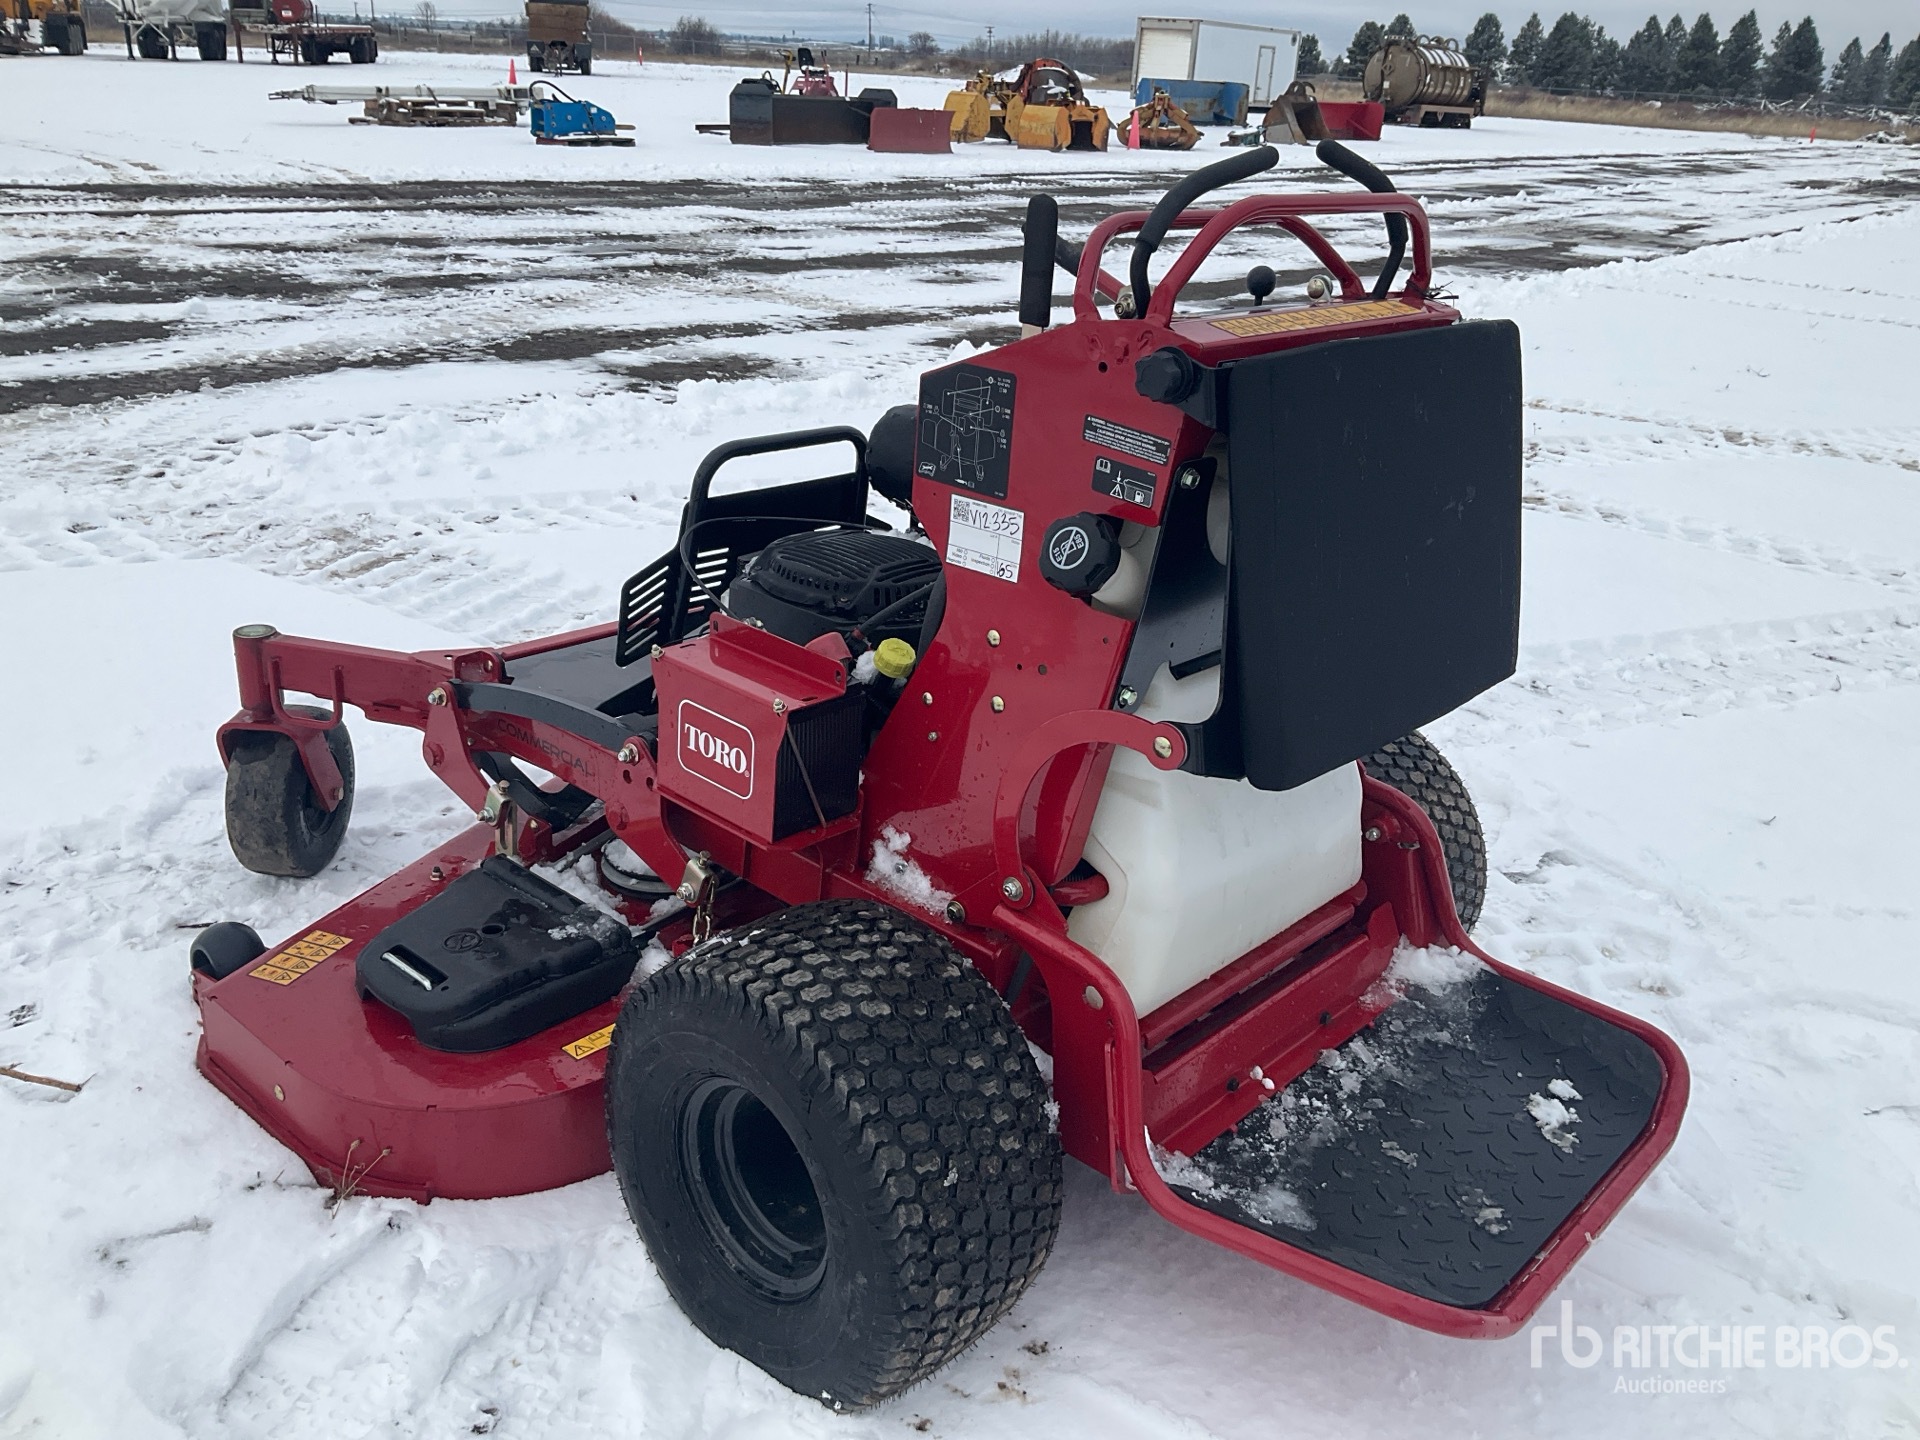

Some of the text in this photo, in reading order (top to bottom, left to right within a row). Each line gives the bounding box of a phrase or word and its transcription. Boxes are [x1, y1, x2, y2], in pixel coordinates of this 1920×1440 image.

[1053, 547, 1063, 562] E15
[1074, 534, 1084, 549] E85
[496, 718, 596, 777] COMMERCIAL
[684, 723, 747, 773] TORO
